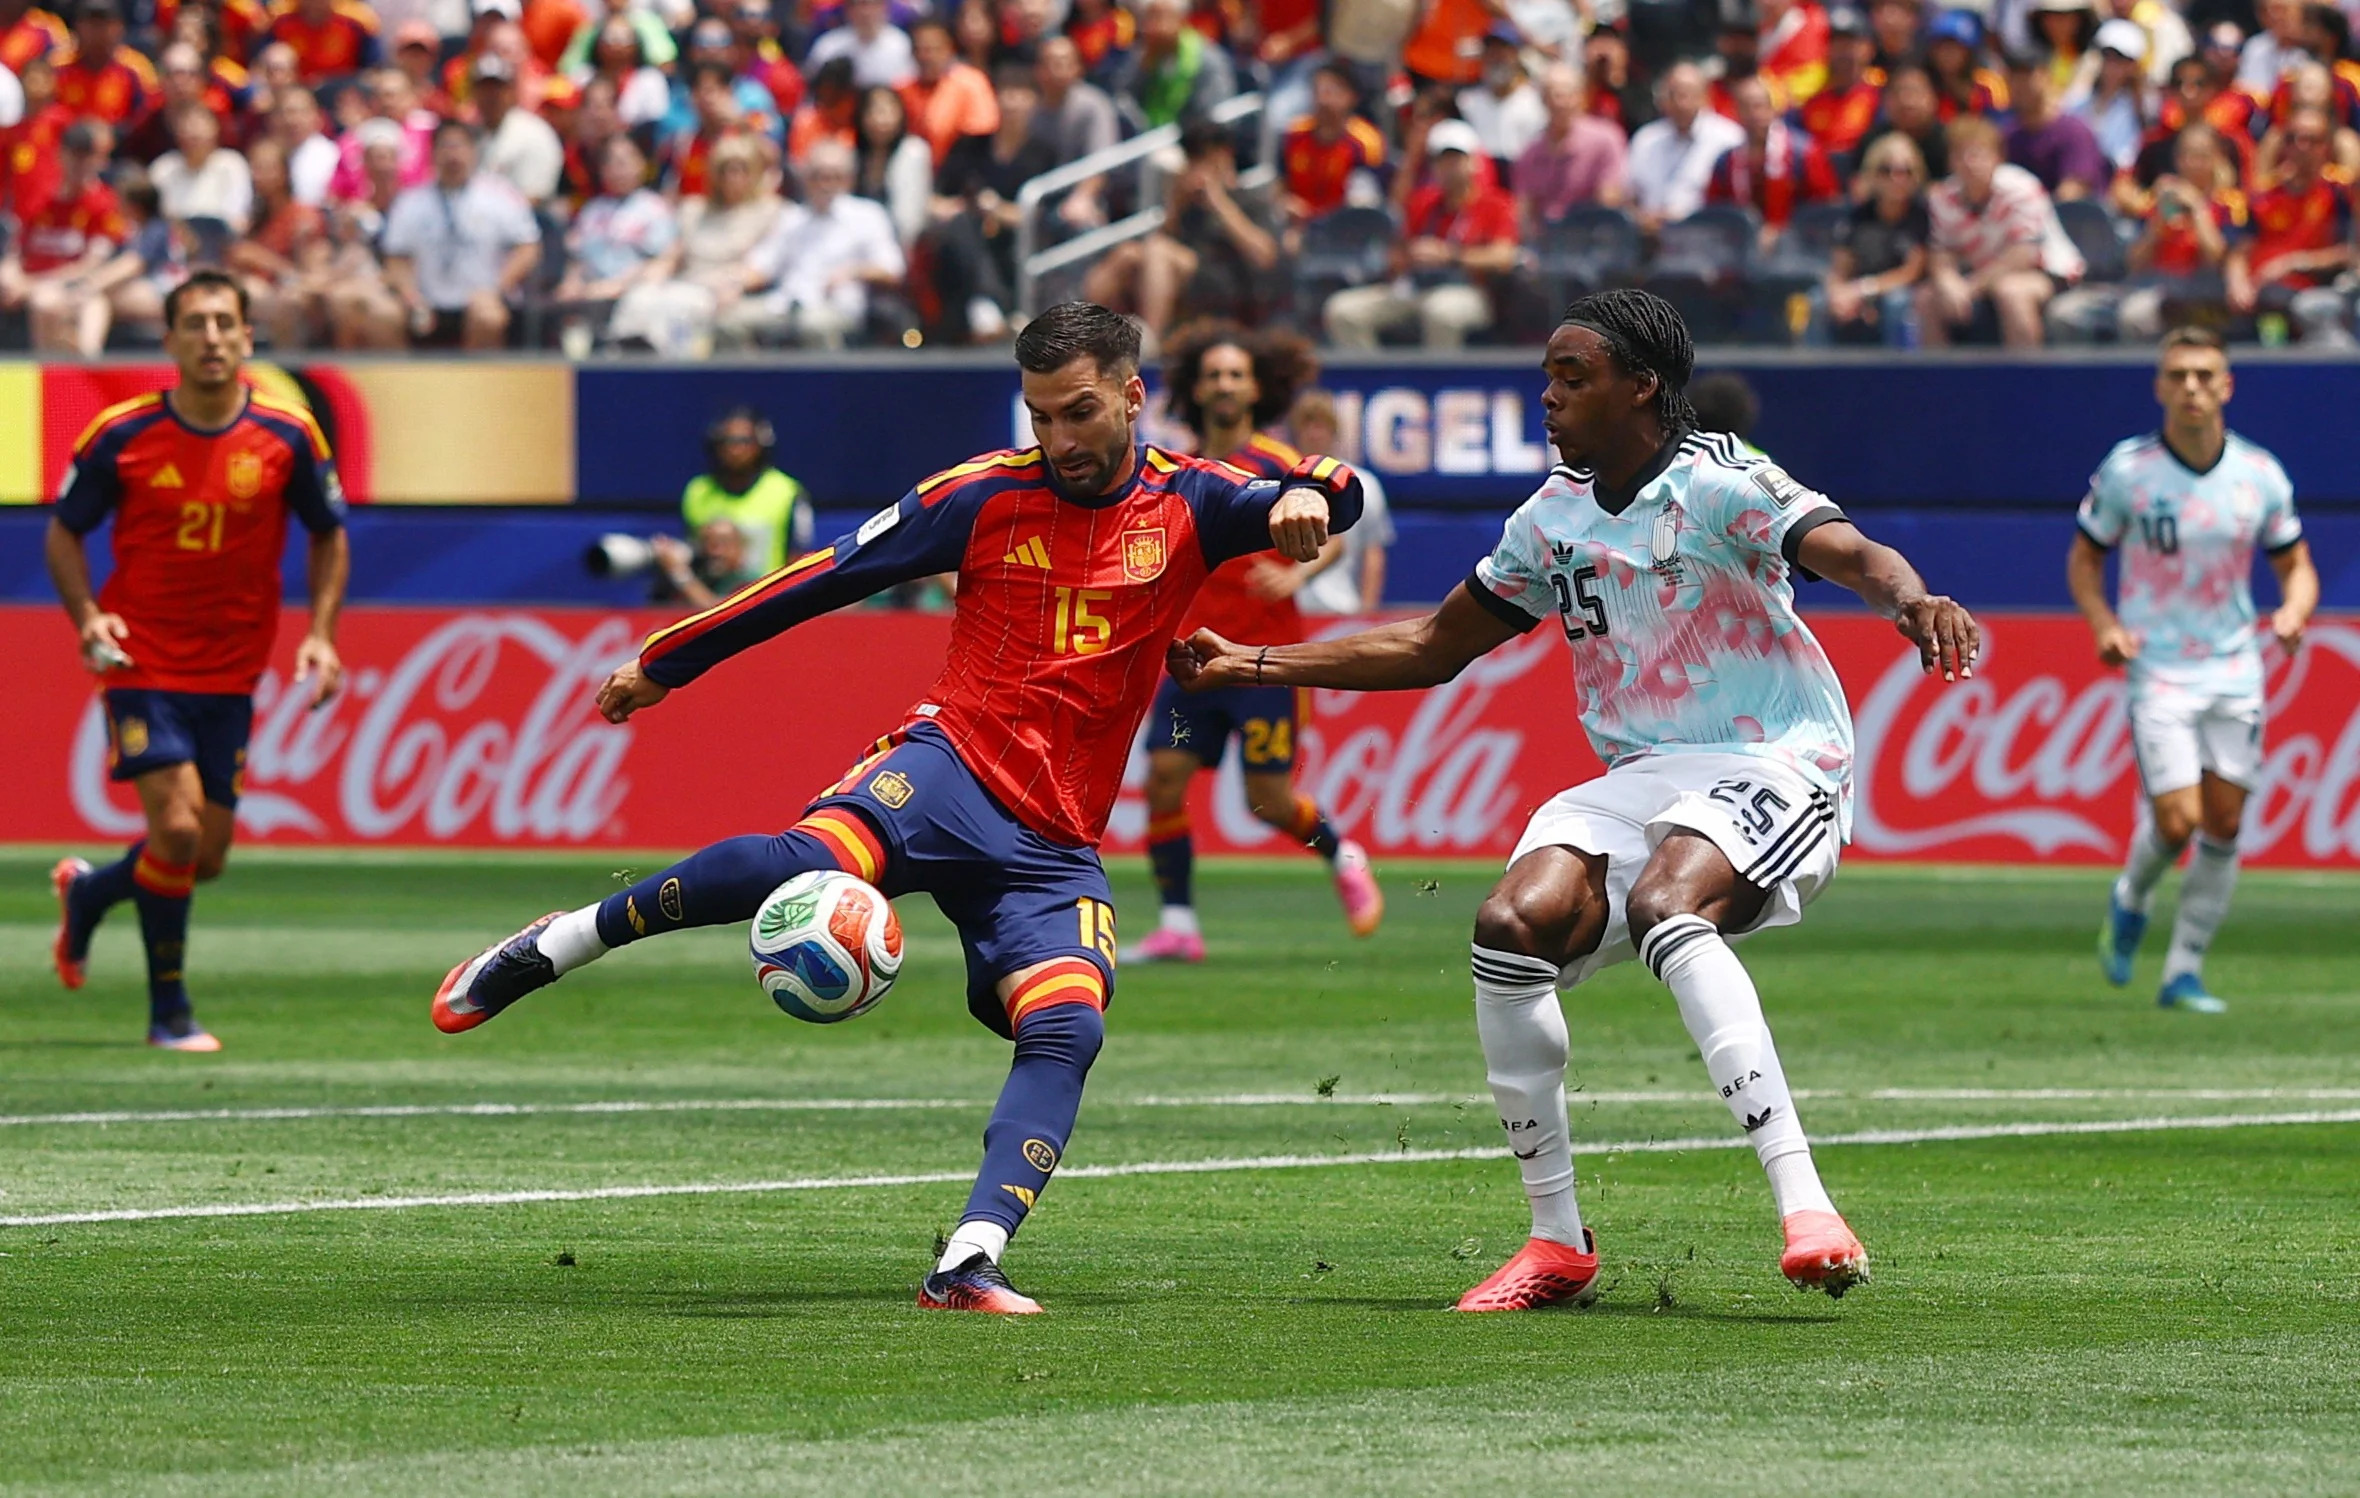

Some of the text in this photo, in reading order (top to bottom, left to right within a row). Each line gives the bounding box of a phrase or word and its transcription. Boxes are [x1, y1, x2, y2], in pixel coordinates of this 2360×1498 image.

[176, 501, 225, 552] 21
[2139, 516, 2178, 555] 10
[1054, 586, 1112, 655] 15
[1551, 565, 1609, 641] 25
[1243, 717, 1291, 764] 24
[1709, 780, 1791, 836] 25
[1076, 896, 1116, 970] 15
[1720, 1069, 1761, 1099] BFA
